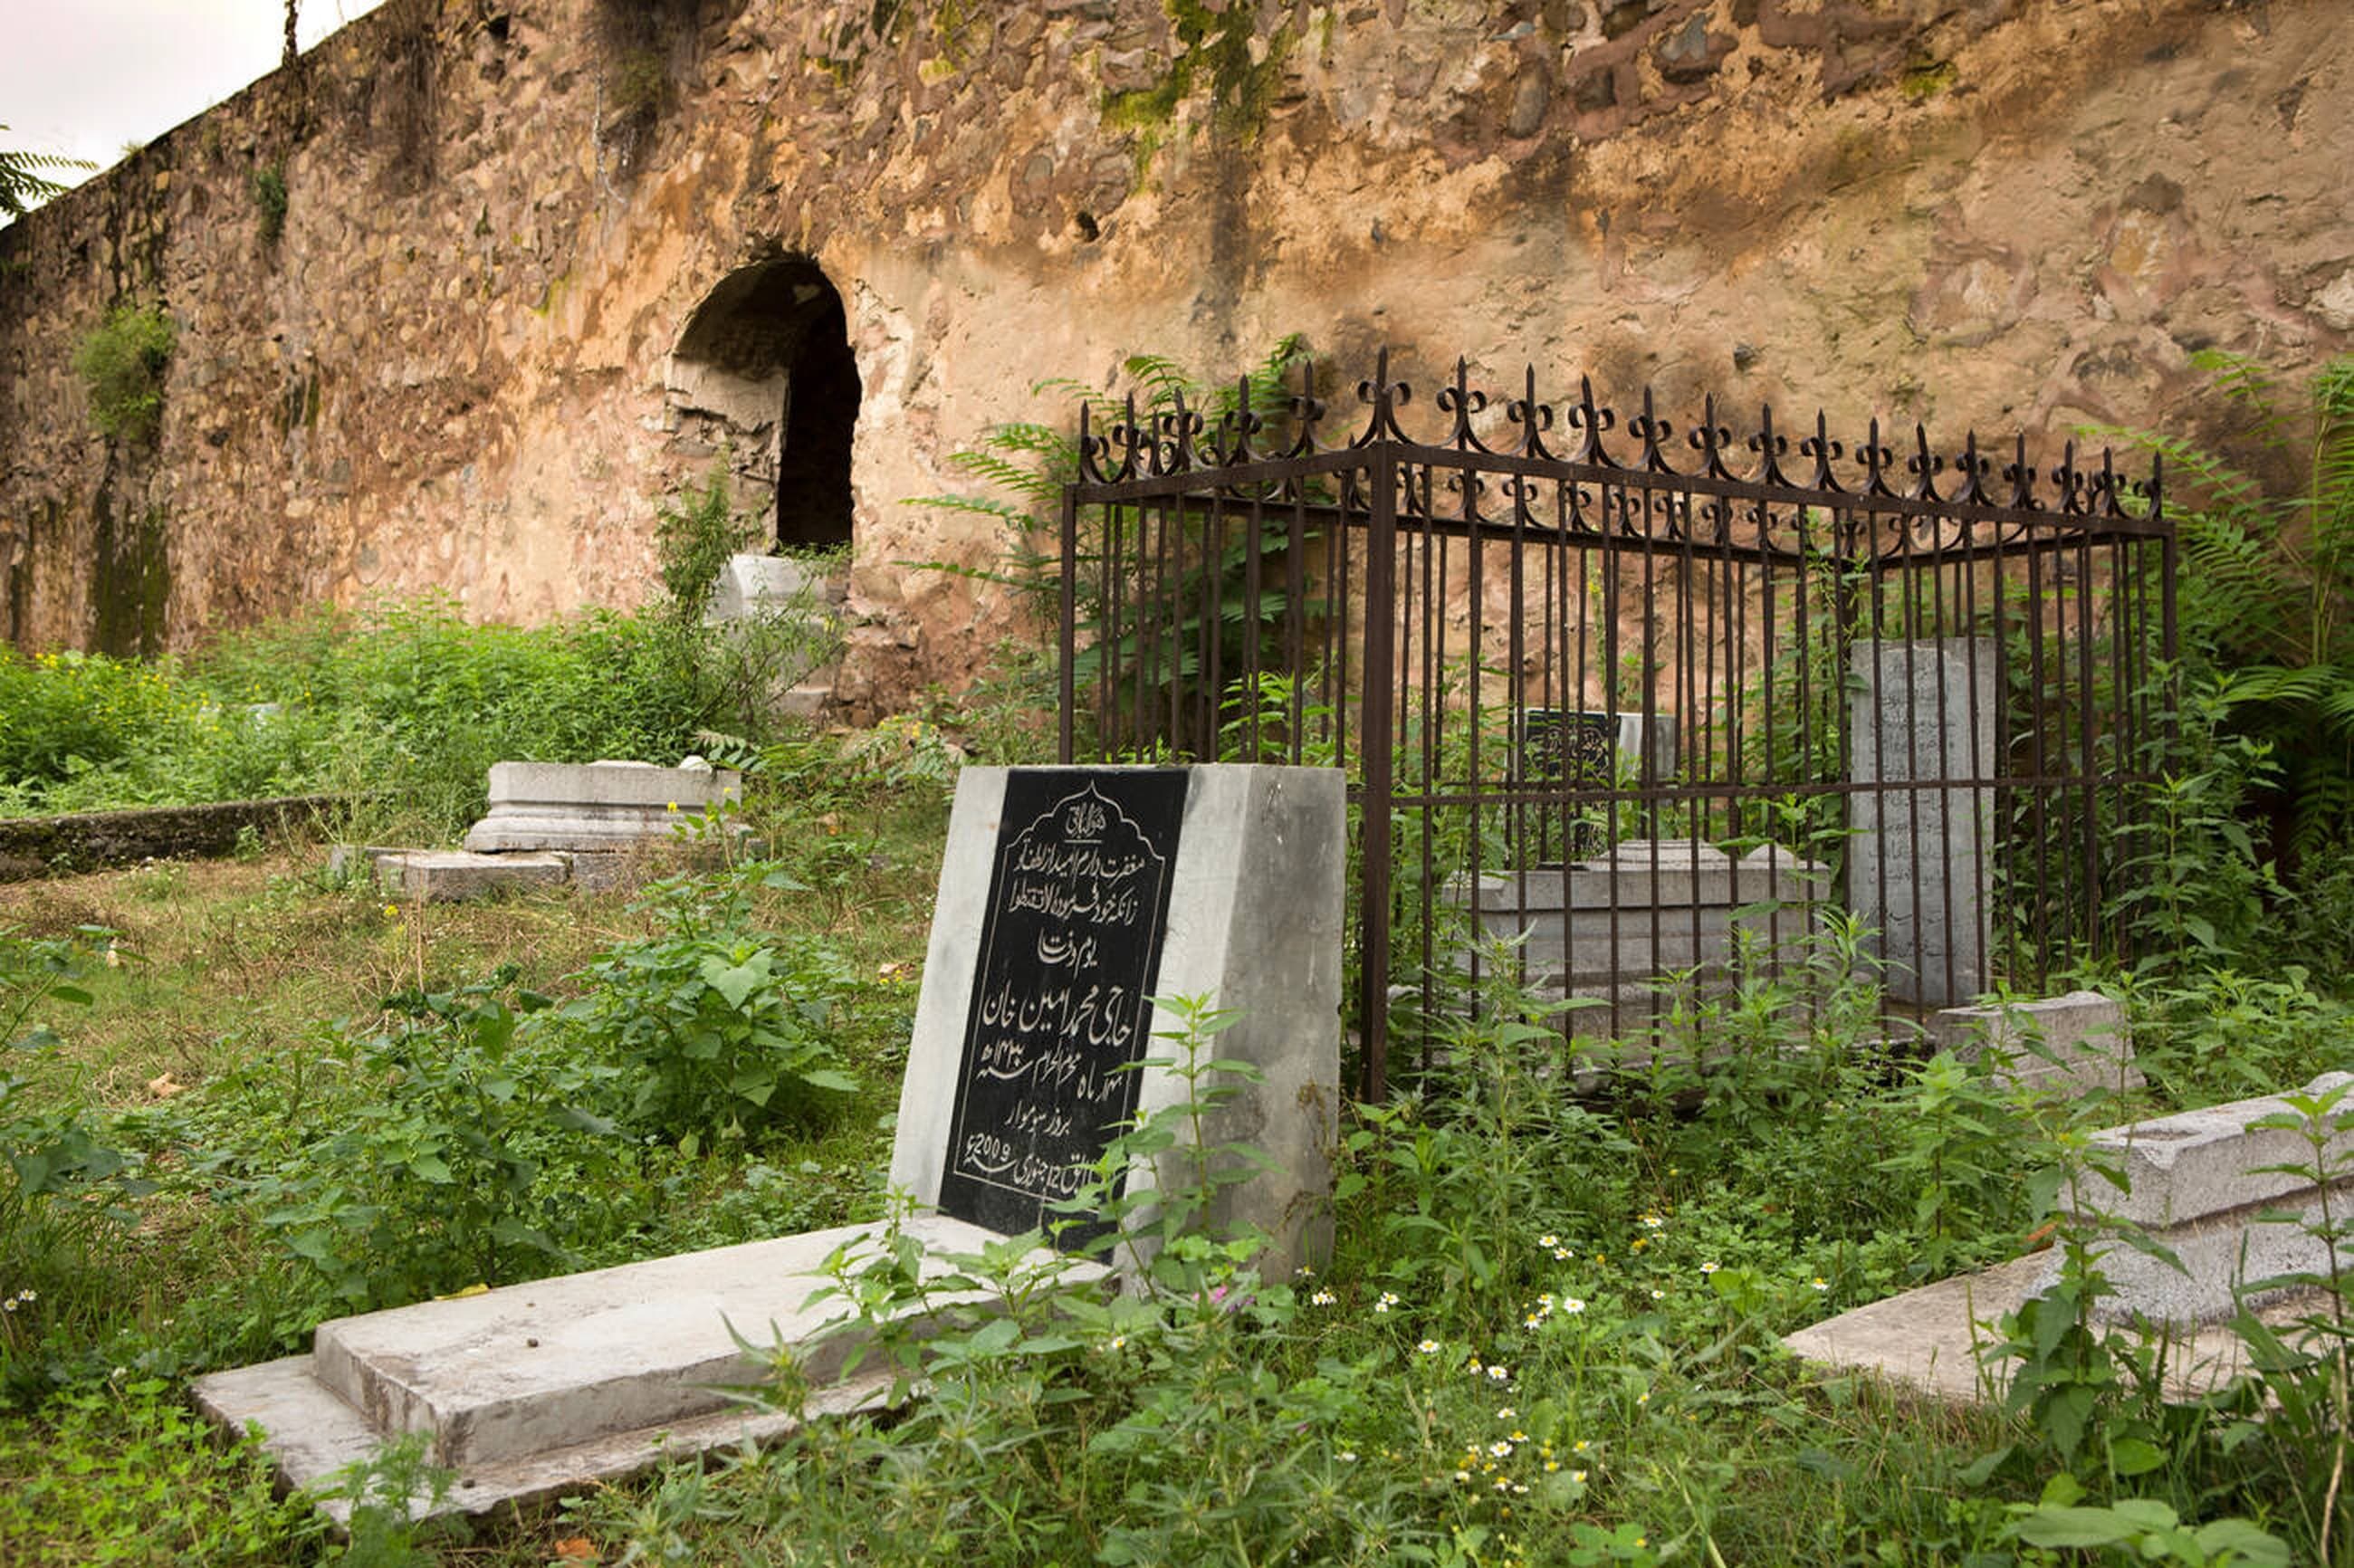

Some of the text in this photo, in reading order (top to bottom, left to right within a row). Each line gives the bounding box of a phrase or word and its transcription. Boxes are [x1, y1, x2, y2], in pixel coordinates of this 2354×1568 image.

[1099, 854, 1144, 888] مغفرت
[1038, 926, 1098, 980] یوم وفات
[982, 979, 1132, 1047] حاجی محمد امین خان
